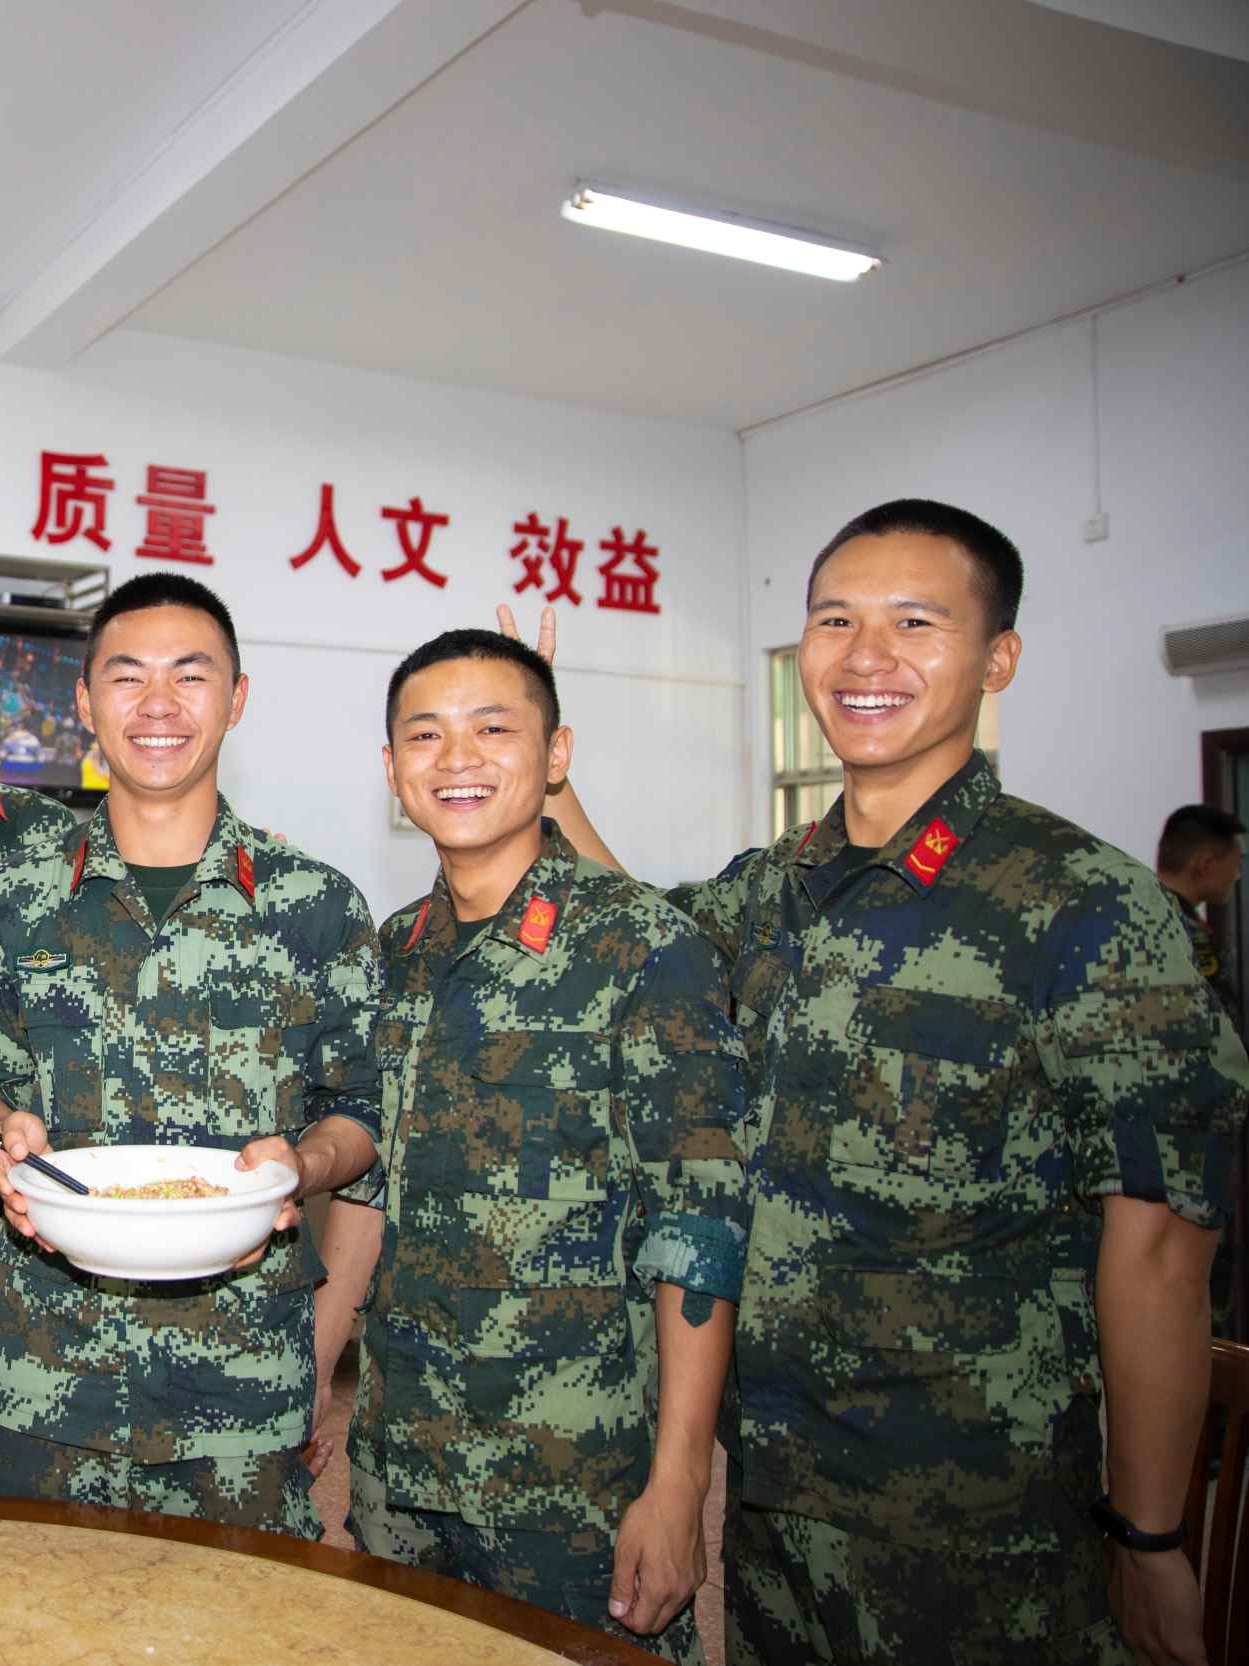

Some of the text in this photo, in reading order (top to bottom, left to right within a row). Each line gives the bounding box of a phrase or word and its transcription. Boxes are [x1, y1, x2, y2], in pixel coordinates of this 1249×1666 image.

[32, 452, 214, 565] 质量
[291, 484, 449, 587] 人文
[510, 513, 660, 614] 效益
